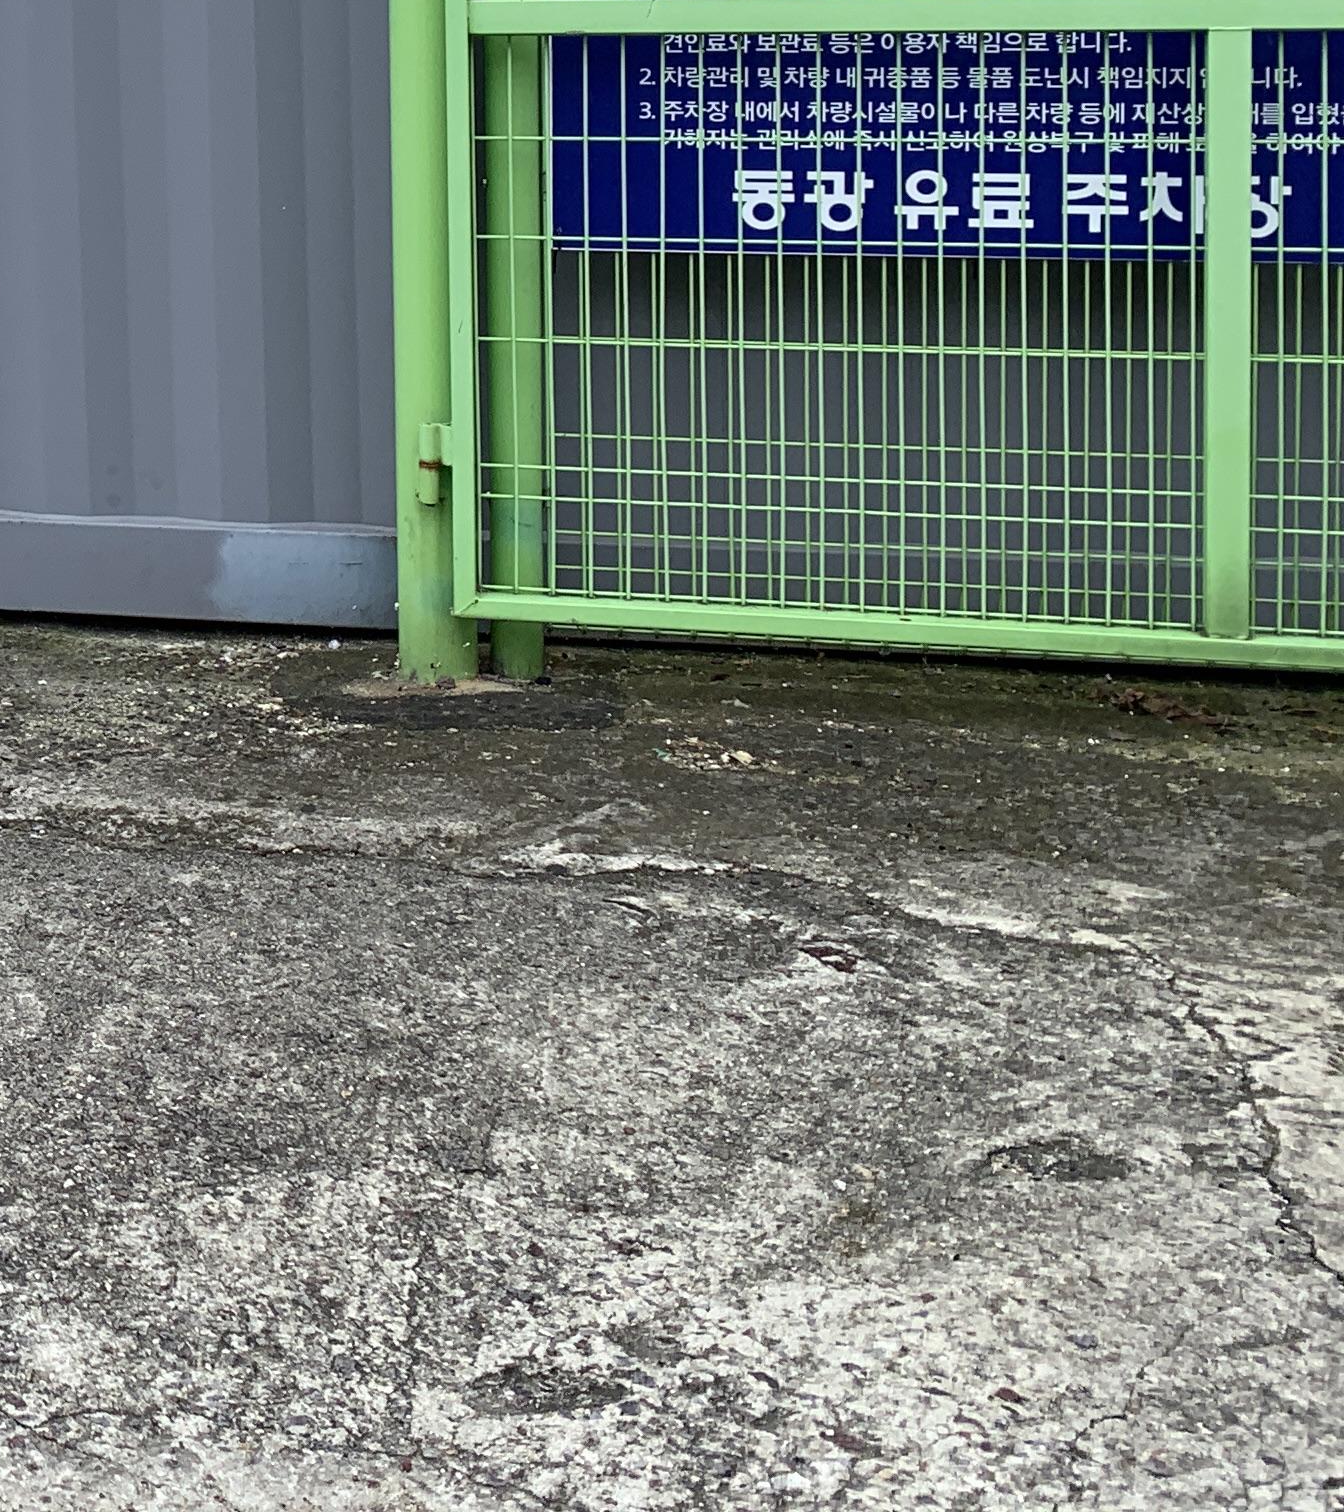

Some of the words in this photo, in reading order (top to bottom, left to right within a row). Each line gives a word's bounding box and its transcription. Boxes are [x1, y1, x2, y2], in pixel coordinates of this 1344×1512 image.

[955, 31, 1050, 55] 책임으로
[638, 67, 657, 86] 2.
[663, 66, 750, 89] 차량관리
[783, 66, 830, 89] 차량
[638, 101, 657, 120] 3.
[663, 100, 730, 123] 주차장
[1025, 101, 1074, 125] 차량
[731, 169, 874, 231] 동광
[894, 169, 1035, 231] 유료
[1065, 171, 1292, 239] 주차장
